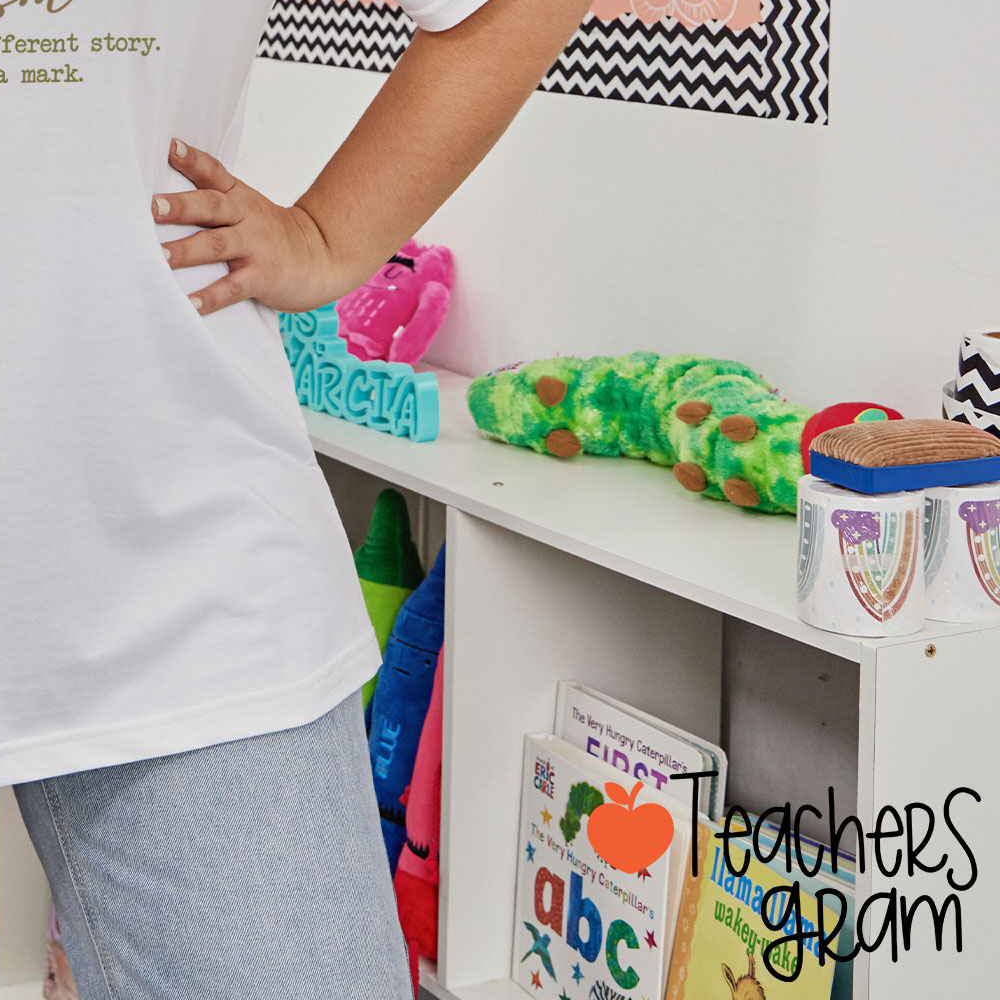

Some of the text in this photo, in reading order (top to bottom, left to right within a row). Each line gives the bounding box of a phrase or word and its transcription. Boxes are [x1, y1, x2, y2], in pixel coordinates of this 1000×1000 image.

[21, 65, 83, 85] mark.
[90, 35, 161, 56] story.
[374, 719, 400, 779] BLUE
[572, 706, 688, 774] The Very Hungry Caterpillar's
[533, 775, 555, 800] CARLE
[535, 761, 555, 786] ERIC
[532, 823, 655, 920] The Very Hungry Caterpillar's
[710, 846, 763, 916] llama
[534, 867, 640, 990] abc
